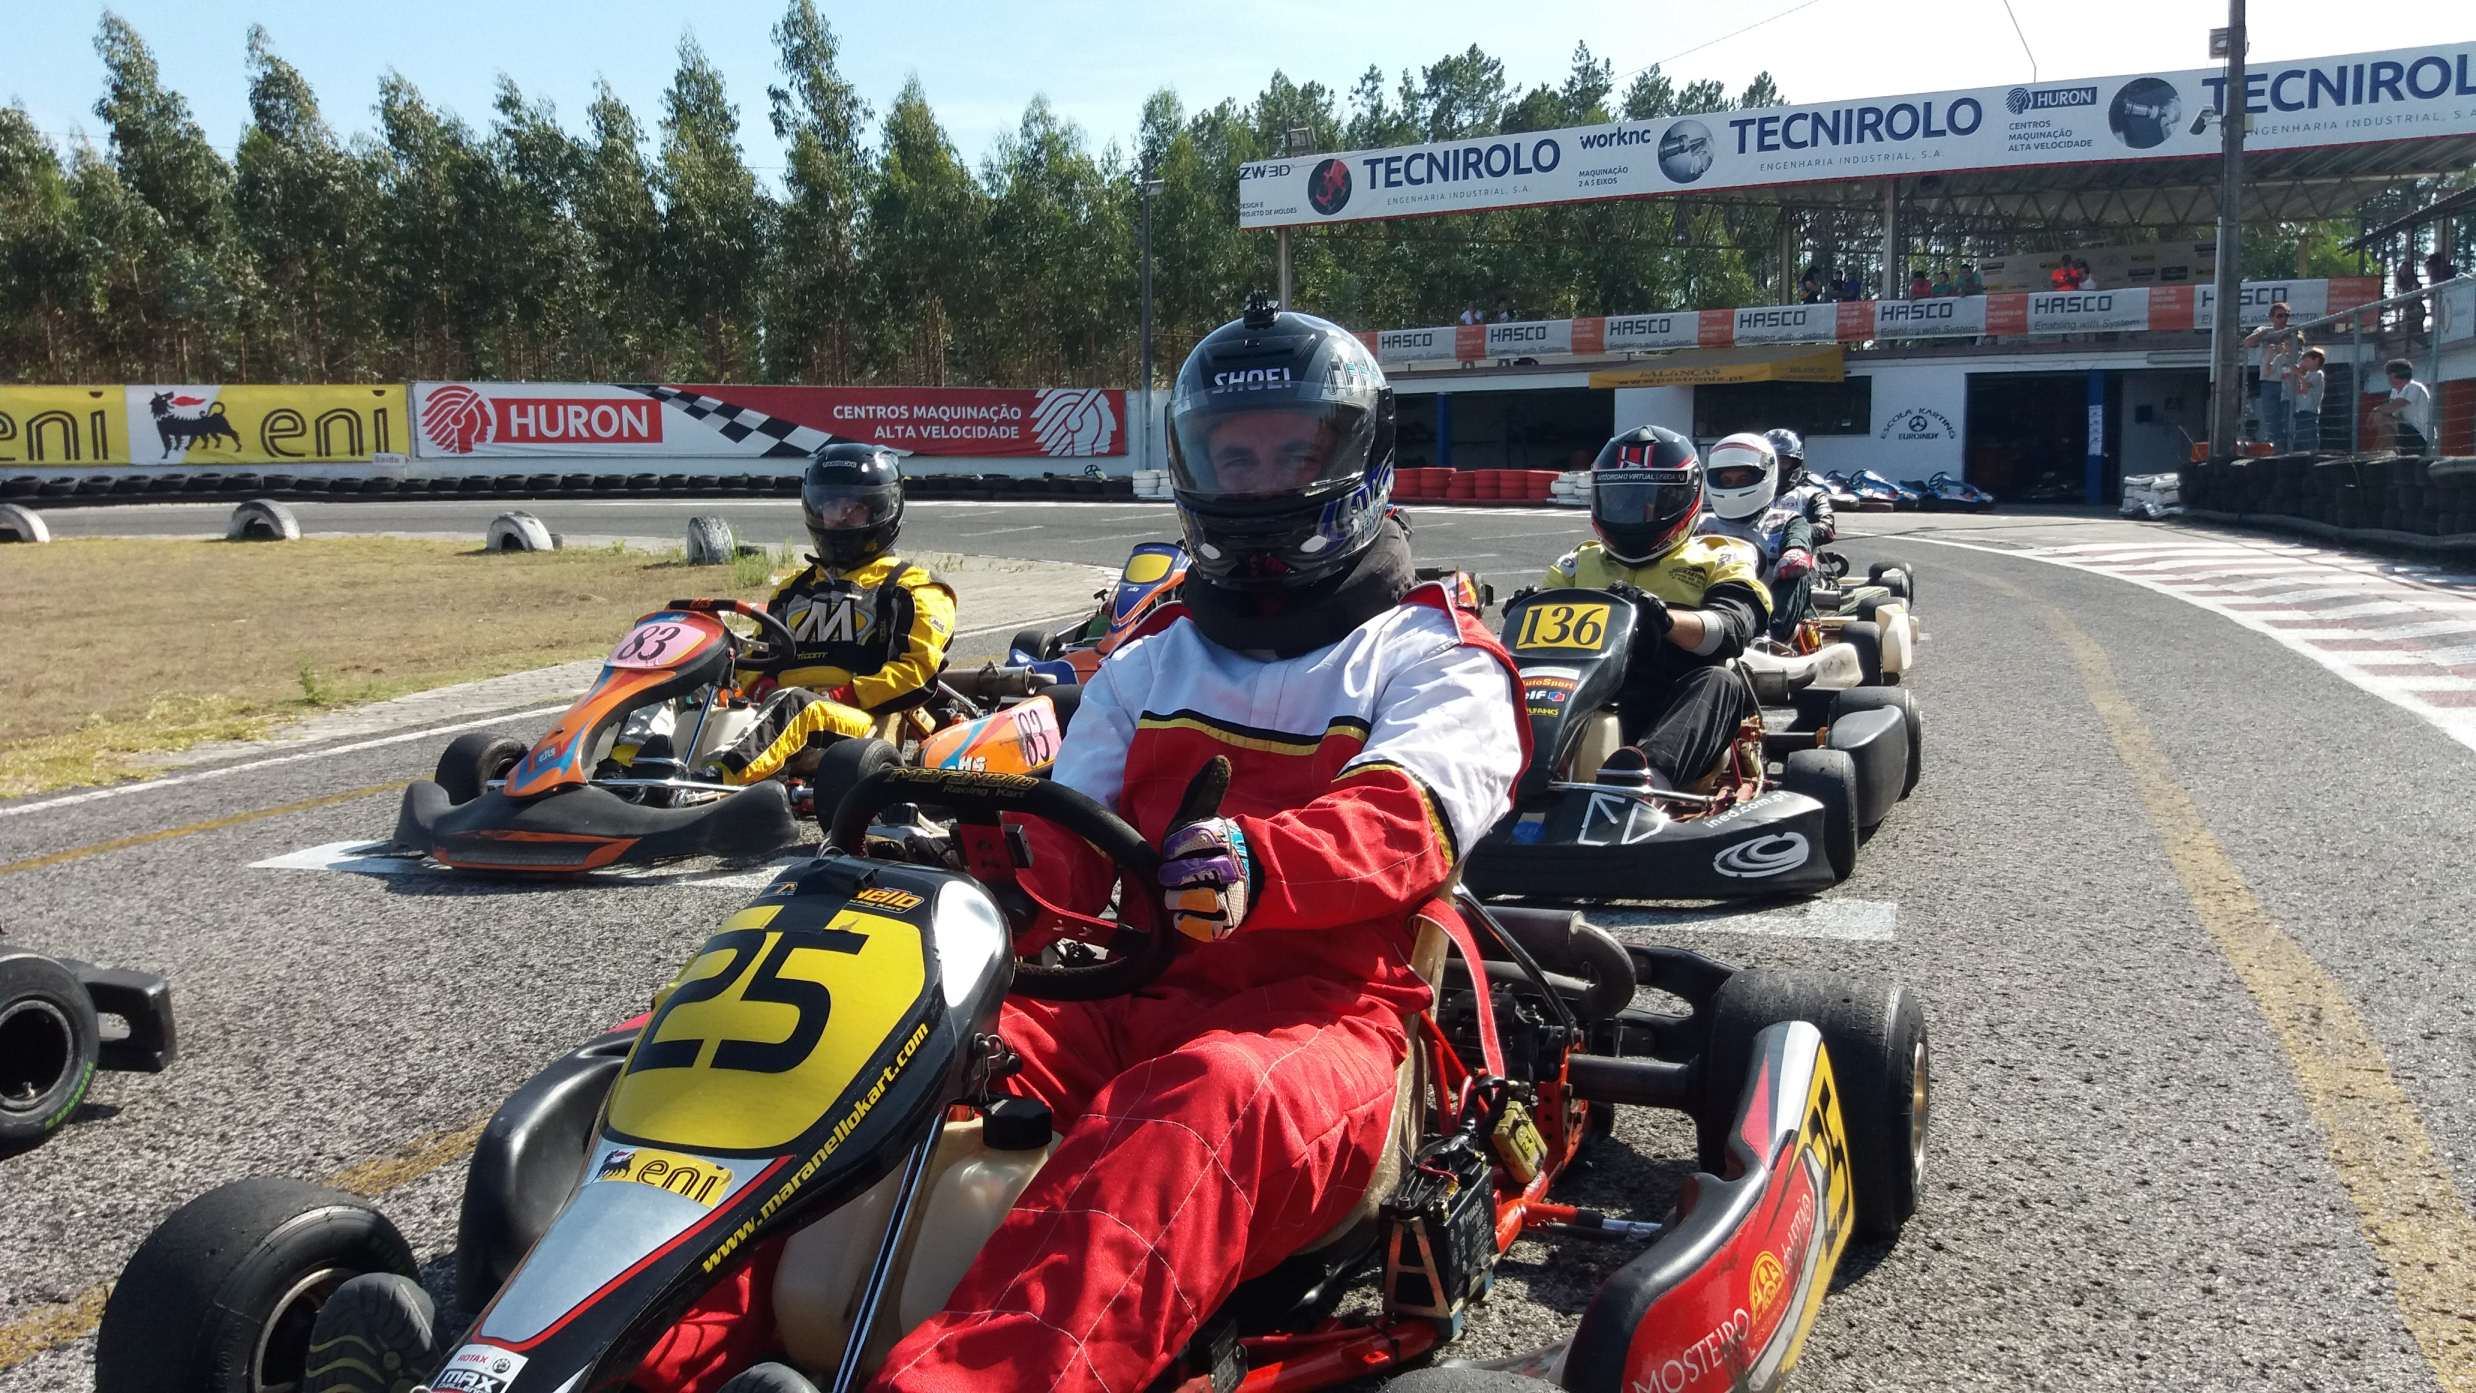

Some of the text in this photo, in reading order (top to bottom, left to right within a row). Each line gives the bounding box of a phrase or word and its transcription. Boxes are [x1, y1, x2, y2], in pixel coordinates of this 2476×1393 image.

[2037, 88, 2092, 107] HURON
[1729, 97, 1982, 154] TECNIROLO
[2009, 120, 2051, 130] CENTROS
[2250, 121, 2338, 136] NGENHARIA
[1580, 126, 1651, 150] worknc
[2008, 128, 2072, 141] MAQUINAÇÃO
[2008, 140, 2093, 152] ALTA VELOCIDADE
[1240, 164, 1291, 180] ZW3D
[1363, 138, 1561, 190] TECNIROLO
[1579, 166, 1628, 178] MAQUINAÇÃO
[1760, 158, 1833, 172] ENGENHARIA
[1596, 177, 1618, 186] EIXOS
[1387, 193, 1445, 206] ENGENHARIA
[2034, 295, 2112, 315] HASCO
[2201, 287, 2288, 307] HSCO
[1740, 311, 1806, 329] HASCO
[1881, 303, 1953, 321] HASCO
[1609, 318, 1671, 336] HASCO
[2079, 319, 2099, 329] with
[1382, 333, 1433, 349] HASCO
[1490, 326, 1547, 343] HASCO
[1212, 368, 1292, 394] SHOEI
[510, 404, 649, 439] HURON
[833, 403, 1022, 423] CENTROS MAQUINAÇÃO
[260, 389, 390, 458] eni
[874, 425, 1019, 439] ALTA VELOCIDADE
[1881, 408, 1956, 440] ESCOLA KARTING
[1899, 432, 1939, 440] EUROINDY
[1629, 472, 1655, 480] VIRTUAL
[1518, 606, 1604, 646] 136
[617, 625, 681, 660] 83
[1018, 708, 1051, 767] 83
[943, 784, 1026, 799] Racing Kart
[626, 928, 870, 1076] 25
[701, 1022, 929, 1274] www.maranellokart.com
[637, 1159, 724, 1204] eni
[457, 1354, 489, 1364] ROTAX
[1632, 1308, 1749, 1393] MOSTEIRO
[442, 1370, 499, 1393] MAX
